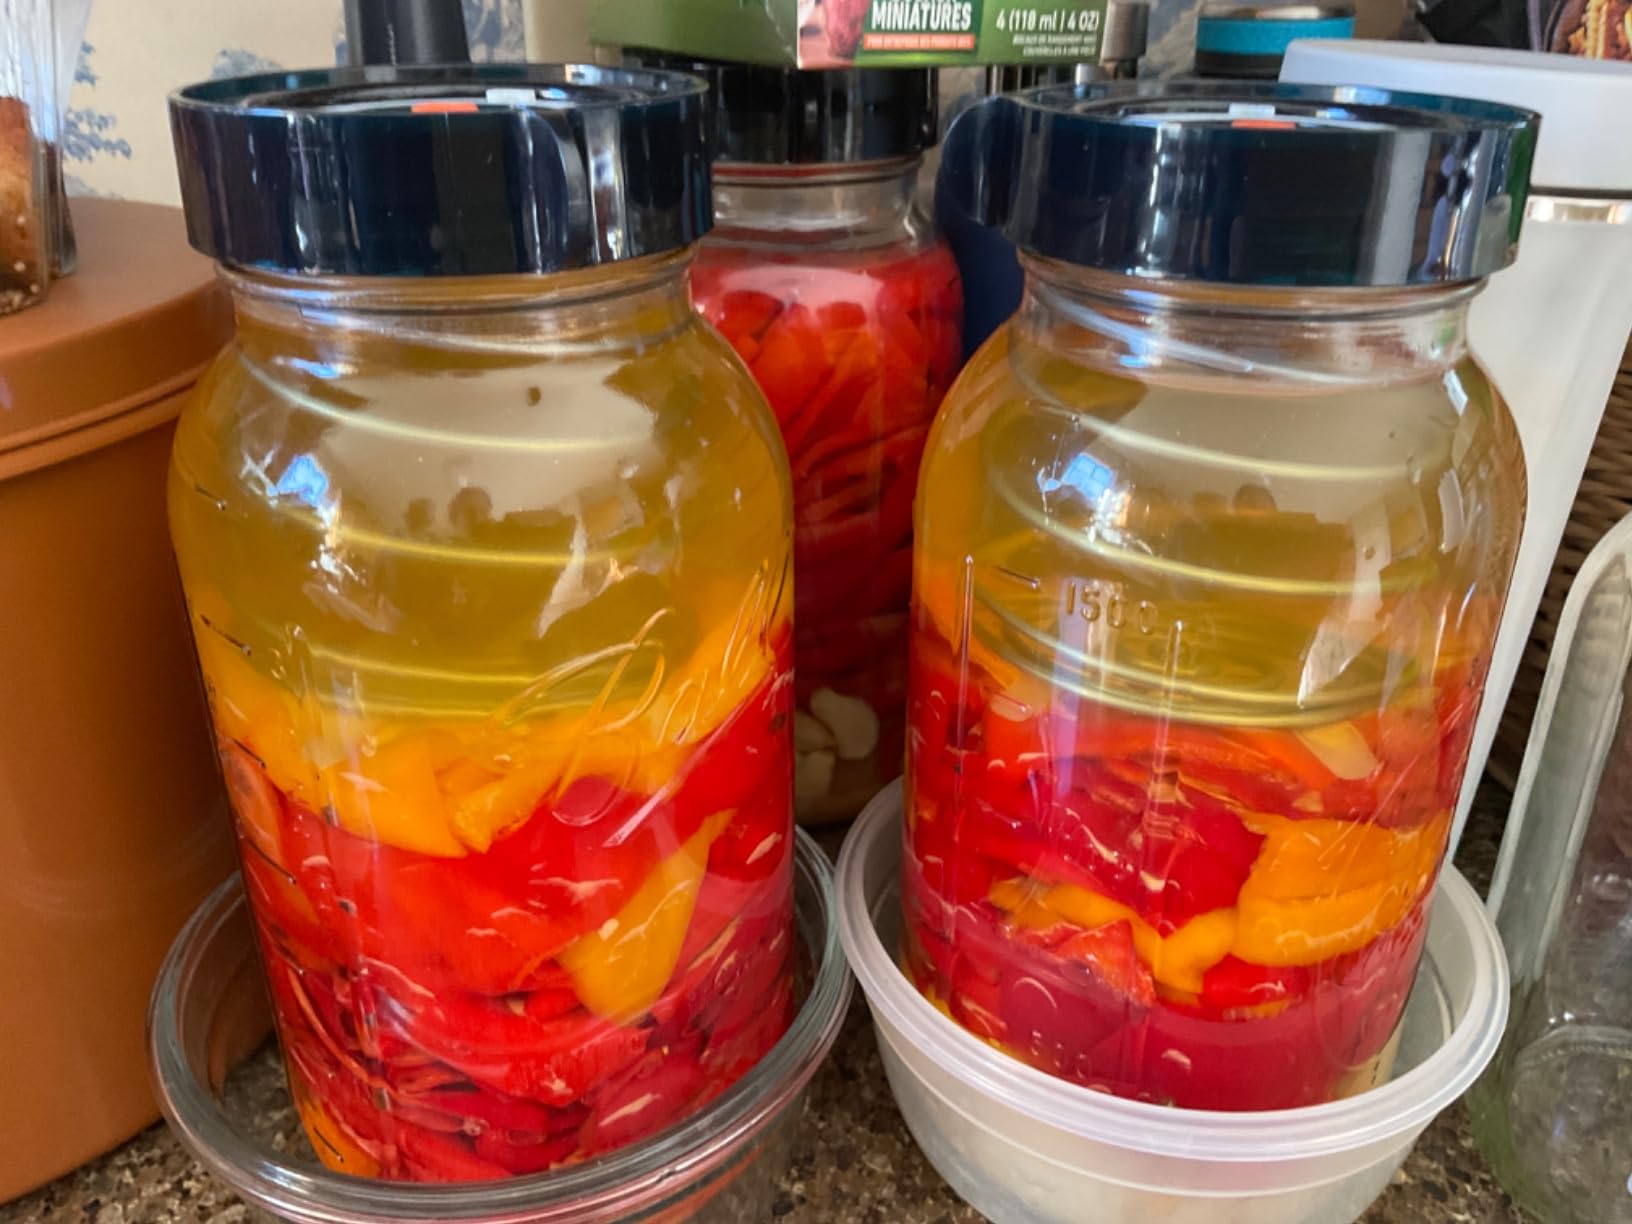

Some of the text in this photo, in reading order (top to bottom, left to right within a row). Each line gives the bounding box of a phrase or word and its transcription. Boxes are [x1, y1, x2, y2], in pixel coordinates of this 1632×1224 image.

[871, 1, 972, 30] MINIATURES
[996, 9, 1006, 31] 4
[1039, 9, 1057, 31] ml
[1067, 11, 1076, 31] 4
[1078, 10, 1100, 31] OZ)
